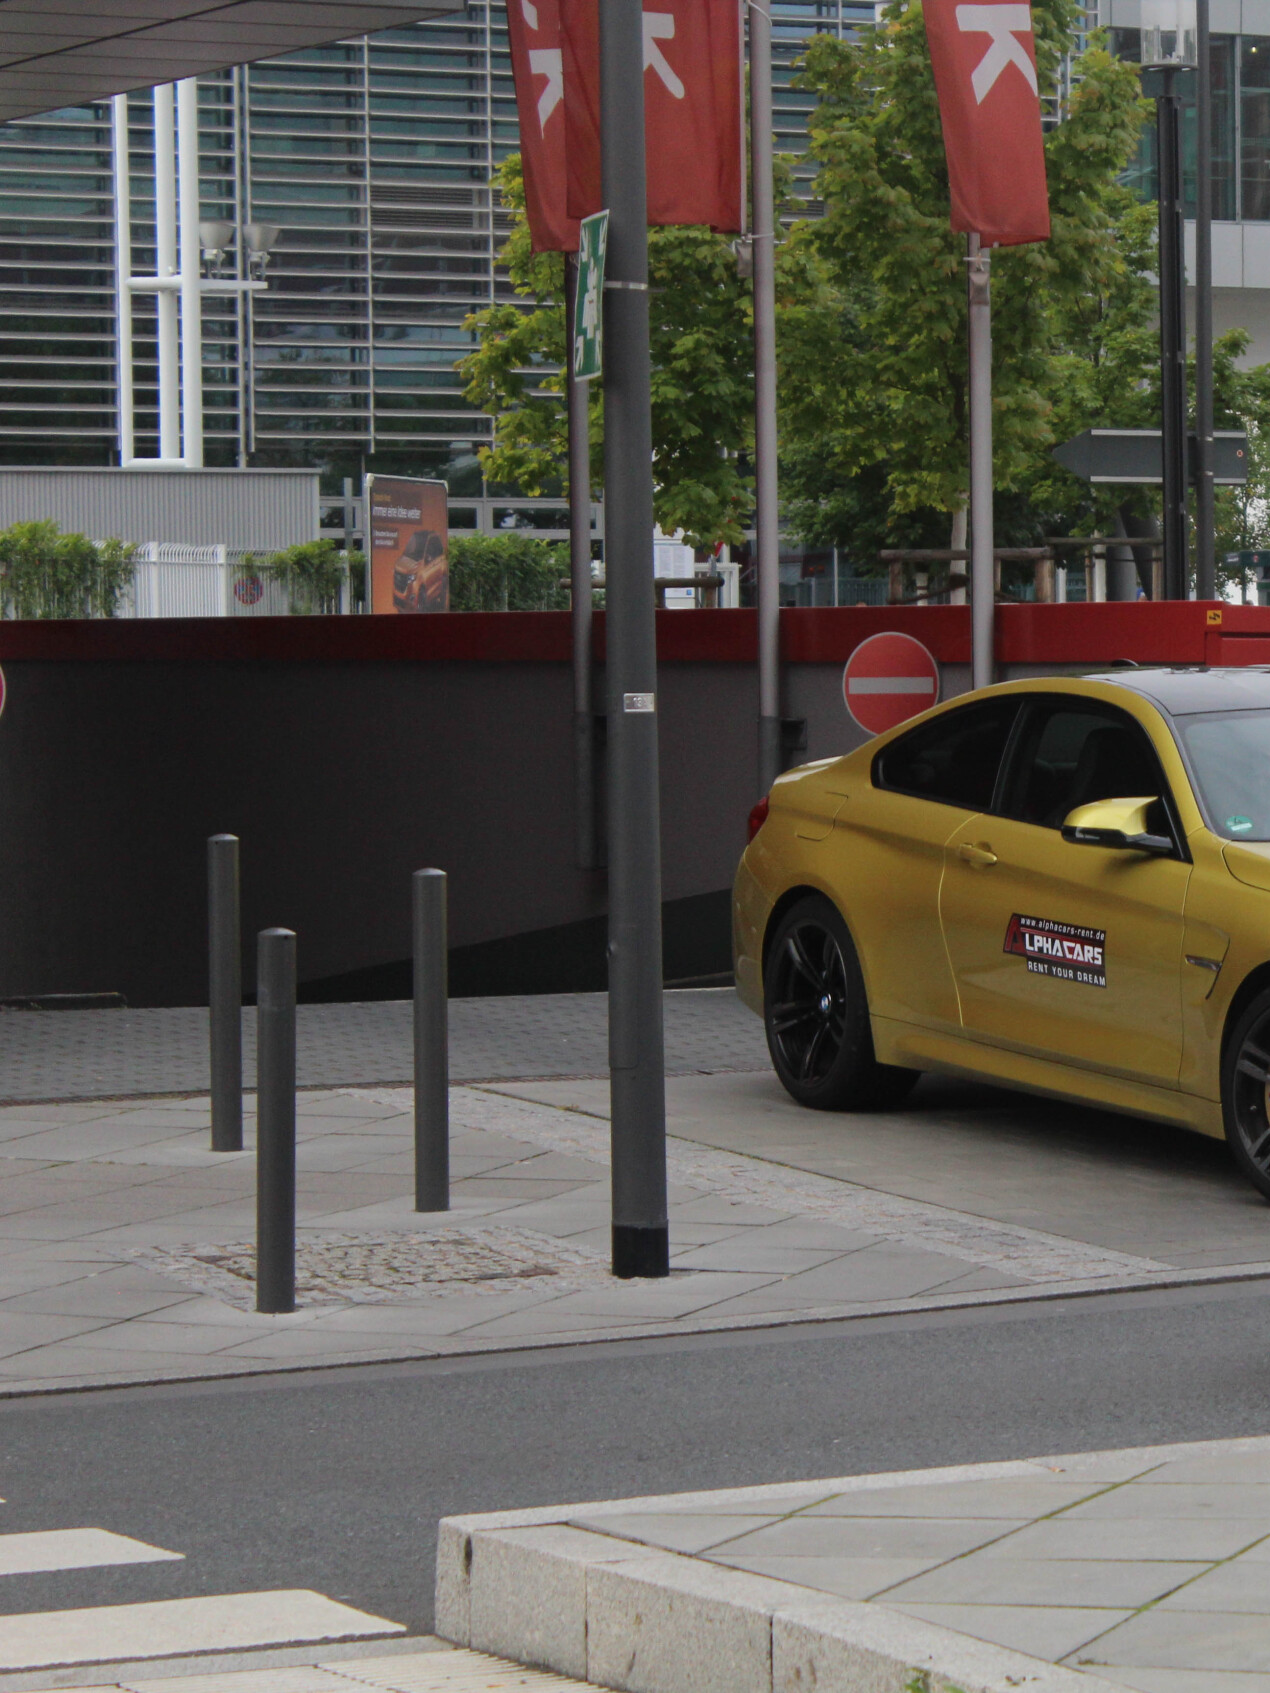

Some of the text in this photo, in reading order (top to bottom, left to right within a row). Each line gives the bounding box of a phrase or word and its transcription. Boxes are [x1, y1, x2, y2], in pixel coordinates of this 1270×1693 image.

[1020, 917, 1105, 940] www.alphacars-rent.de
[1028, 961, 1106, 986] RENT YOUR DREAM
